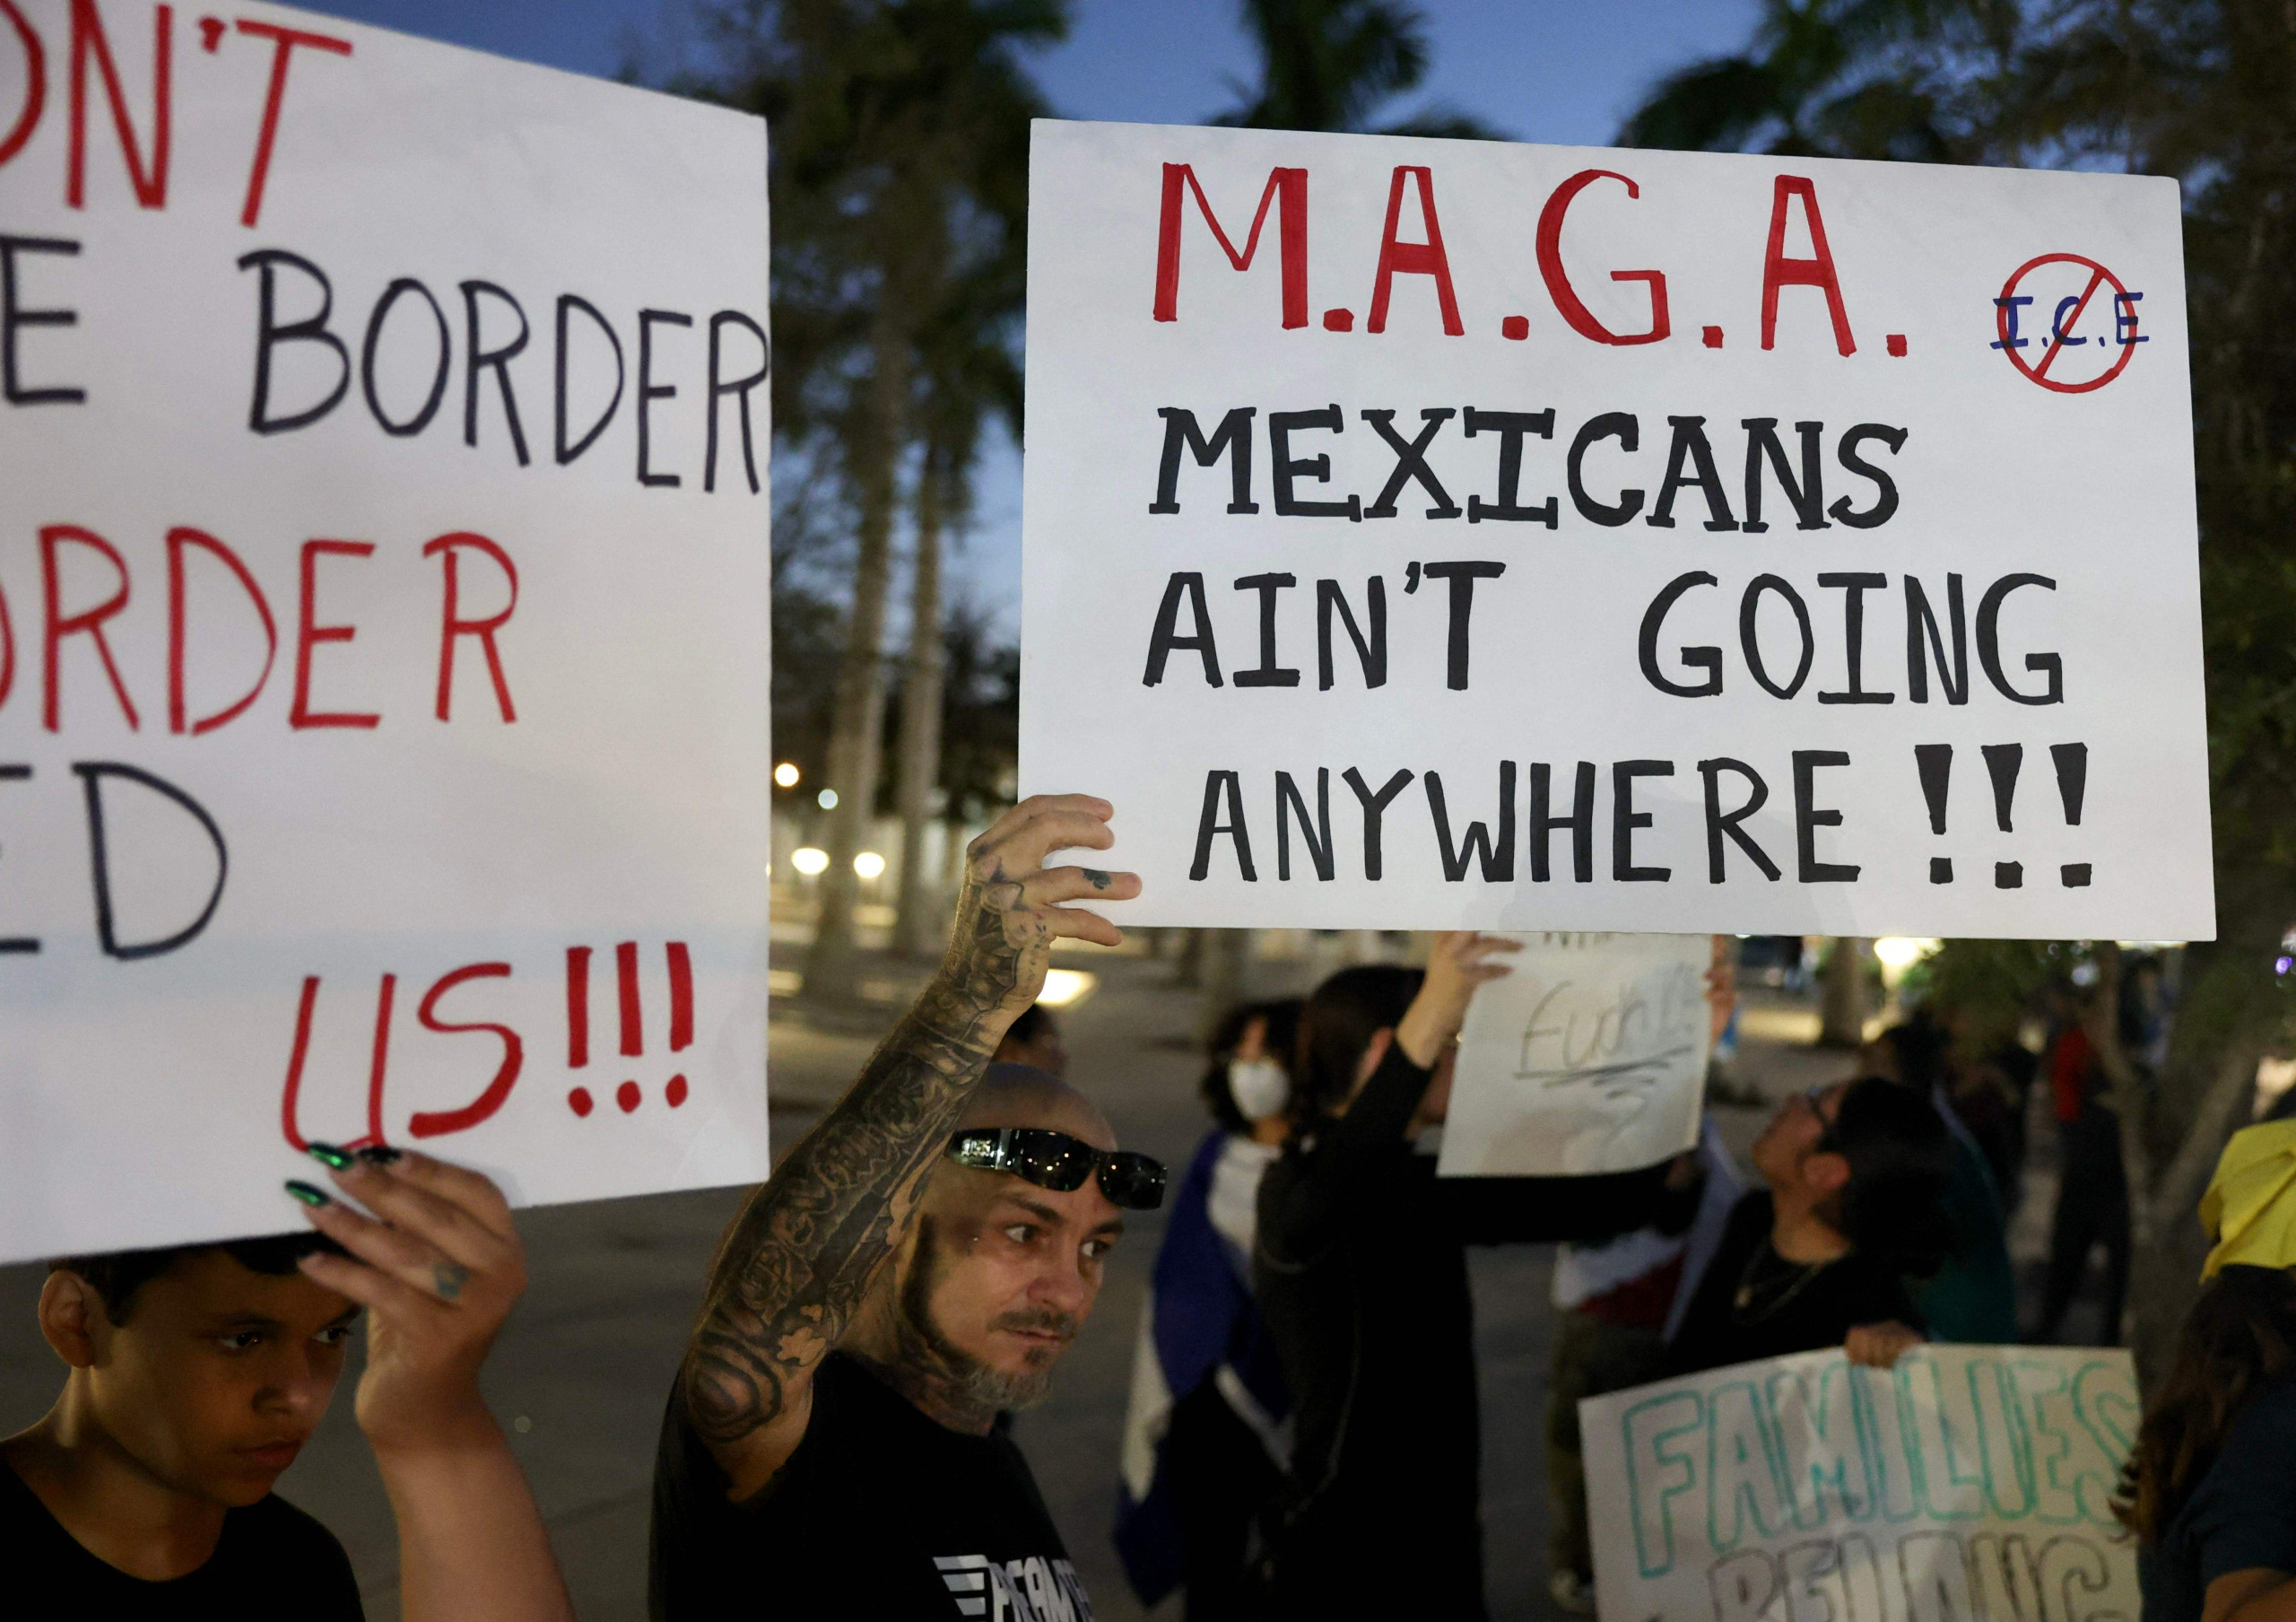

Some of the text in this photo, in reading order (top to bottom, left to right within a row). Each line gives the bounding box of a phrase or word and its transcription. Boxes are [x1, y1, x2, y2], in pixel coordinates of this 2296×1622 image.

[1153, 162, 1908, 357] M.A.G.A.
[1990, 292, 2150, 350] I.C.E
[238, 249, 769, 495] BORDER
[1149, 404, 1909, 533] MEXICANS
[0, 523, 518, 737] RDER
[1143, 561, 2065, 705] AIN'T GOING
[0, 761, 227, 962] D
[1189, 750, 1862, 885] ANYWHERE
[1622, 1356, 2142, 1578] FAMILIES
